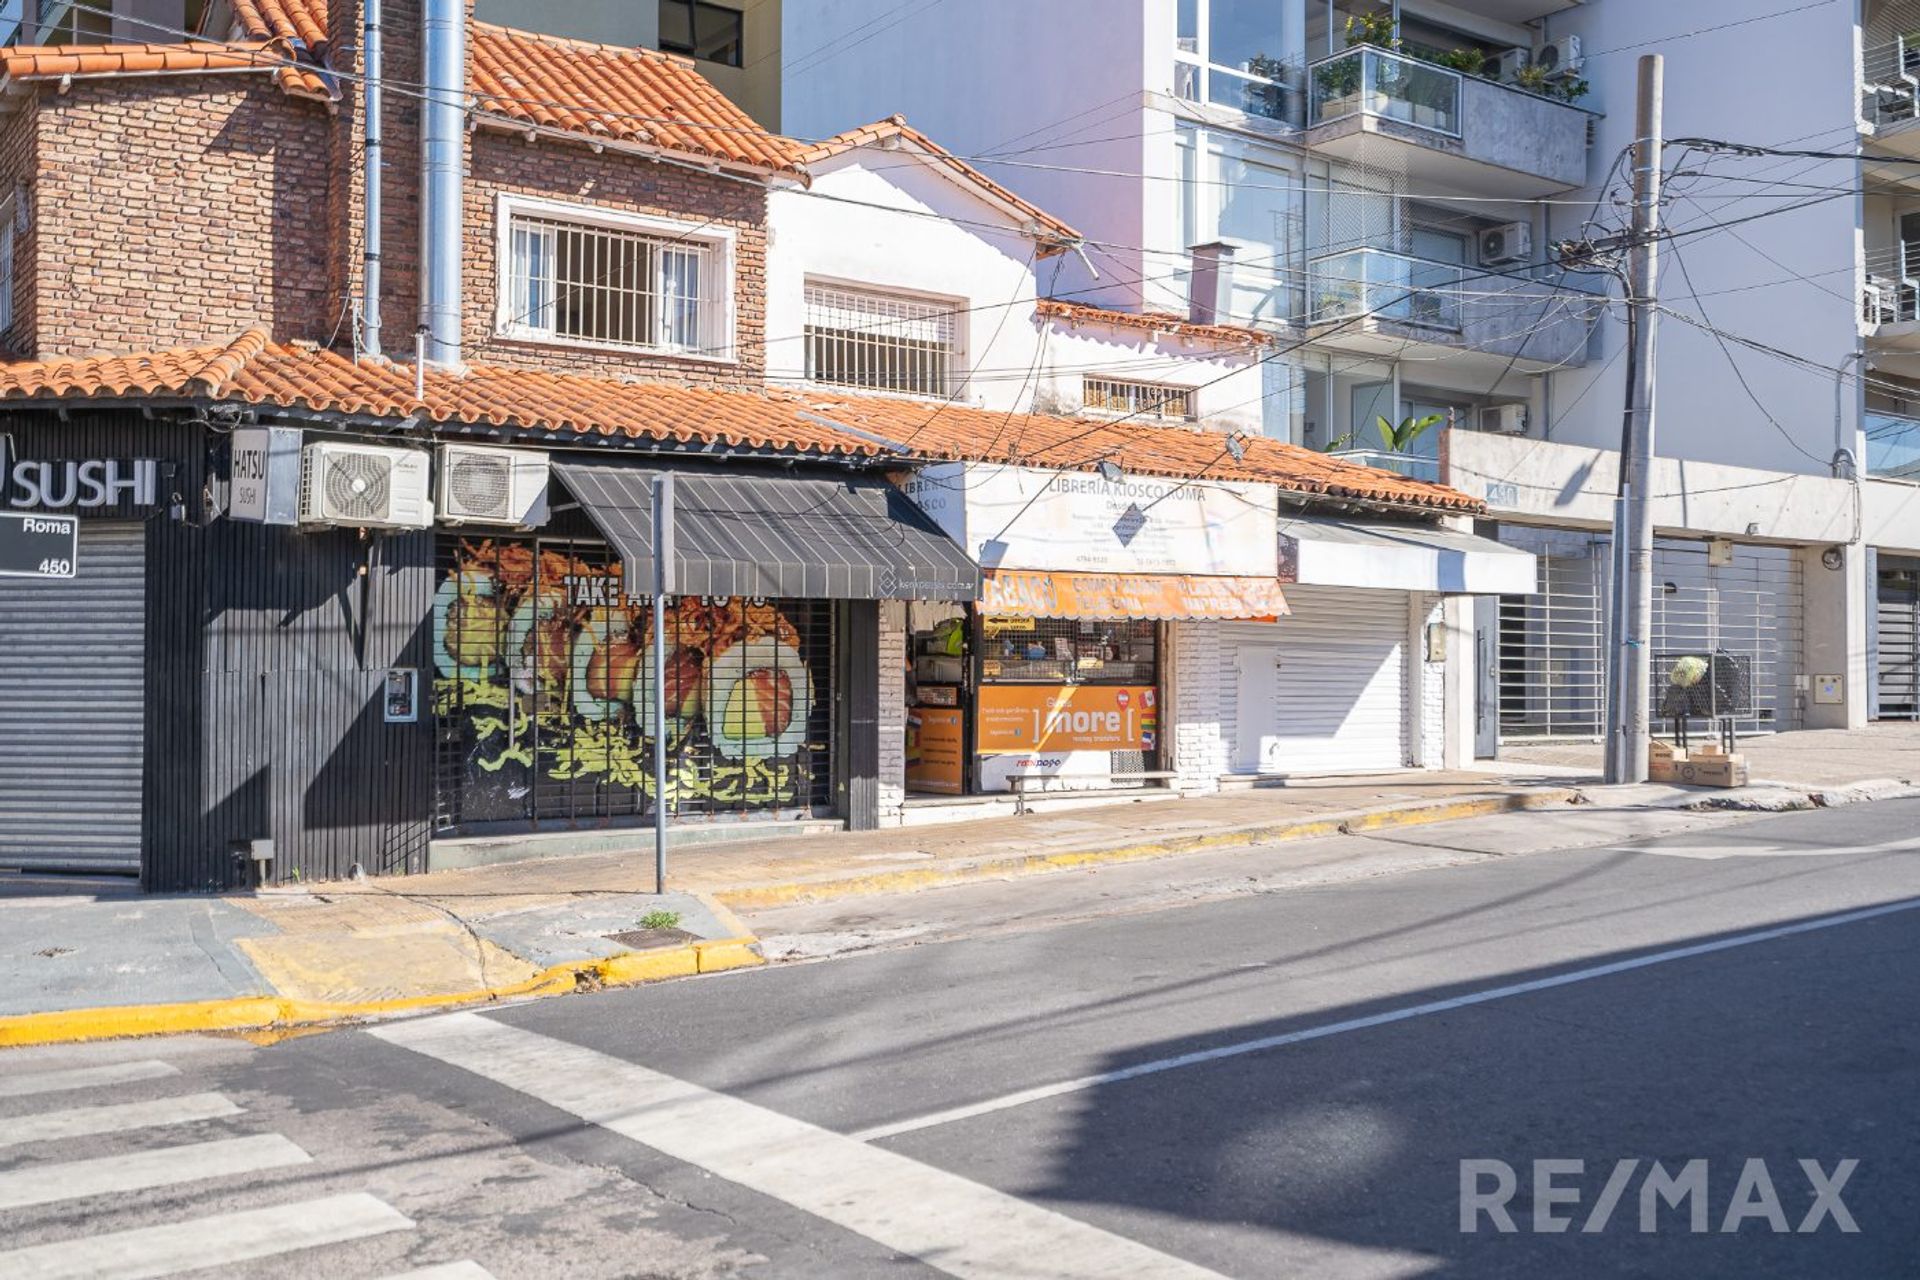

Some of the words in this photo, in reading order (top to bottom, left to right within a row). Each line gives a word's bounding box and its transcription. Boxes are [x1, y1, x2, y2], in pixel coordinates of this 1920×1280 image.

[234, 450, 266, 480] HATSU
[10, 460, 157, 508] SUSHI
[1113, 482, 1163, 499] KIOSCO
[1167, 486, 1206, 501] ROMA
[238, 487, 256, 504] SUSHI
[23, 518, 71, 535] Roma
[38, 558, 71, 575] 450
[564, 576, 619, 606] TAKE
[1045, 711, 1121, 733] more
